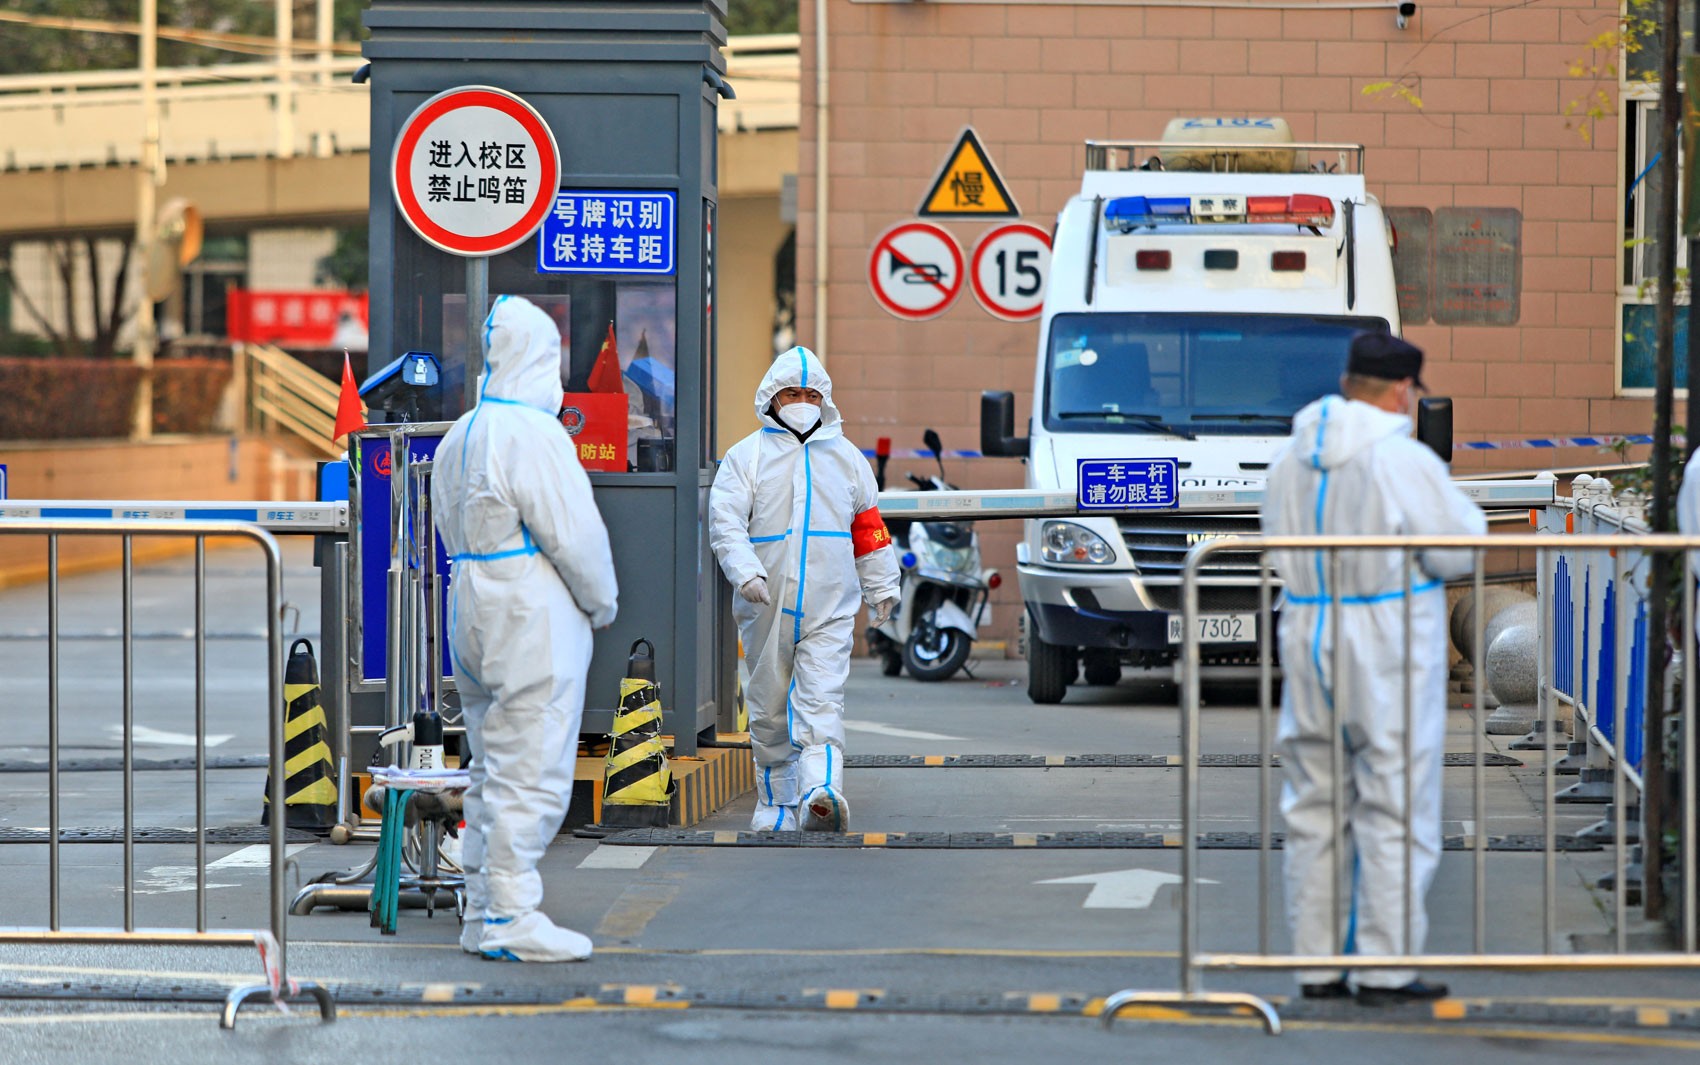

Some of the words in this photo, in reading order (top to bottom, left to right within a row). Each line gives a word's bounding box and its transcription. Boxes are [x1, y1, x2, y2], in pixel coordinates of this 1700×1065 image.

[429, 140, 526, 170] 进入校区
[428, 174, 527, 204] 禁止鸣笛
[950, 171, 985, 207] 慢
[553, 198, 662, 229] 号牌识别
[1199, 198, 1238, 211] 警察
[552, 233, 662, 263] 保持车距
[996, 249, 1041, 297] 15
[575, 443, 616, 460] 防站
[1088, 463, 1168, 483] 一车一杆
[1087, 483, 1168, 503] 请勿跟车
